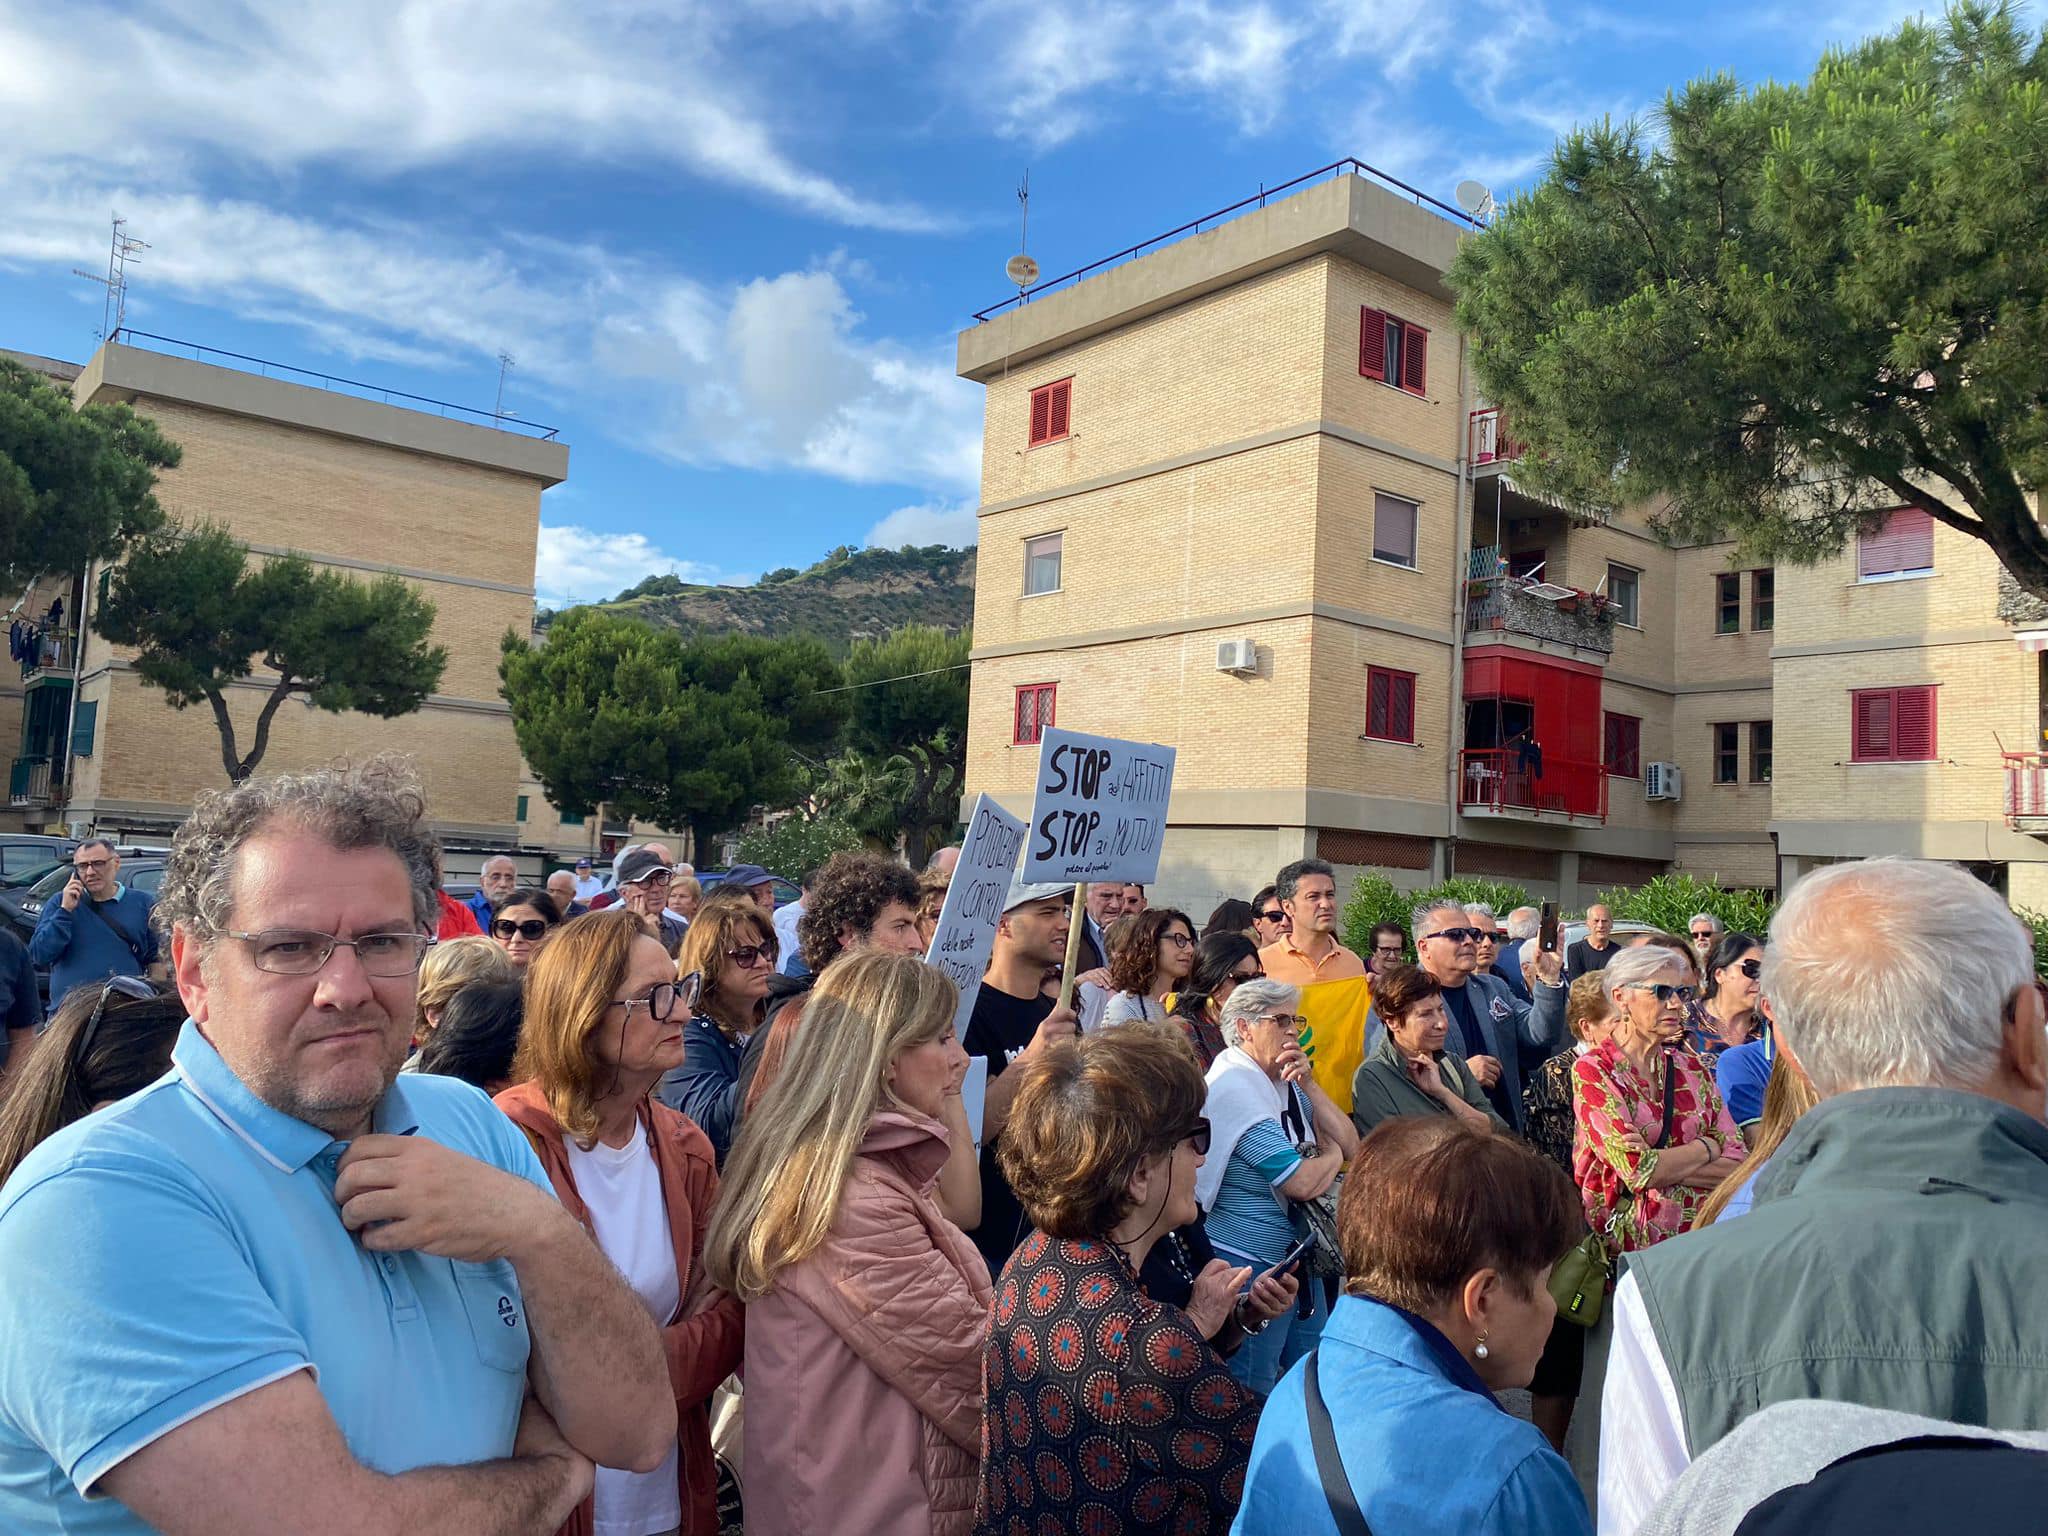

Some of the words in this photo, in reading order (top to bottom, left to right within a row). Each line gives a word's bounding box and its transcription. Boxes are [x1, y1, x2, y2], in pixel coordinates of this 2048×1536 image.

[1045, 744, 1111, 800] STOP
[1120, 756, 1169, 803] AFFITTI
[1035, 809, 1101, 861] STOP
[1095, 835, 1109, 855] ai
[1109, 817, 1158, 857] MUTUI
